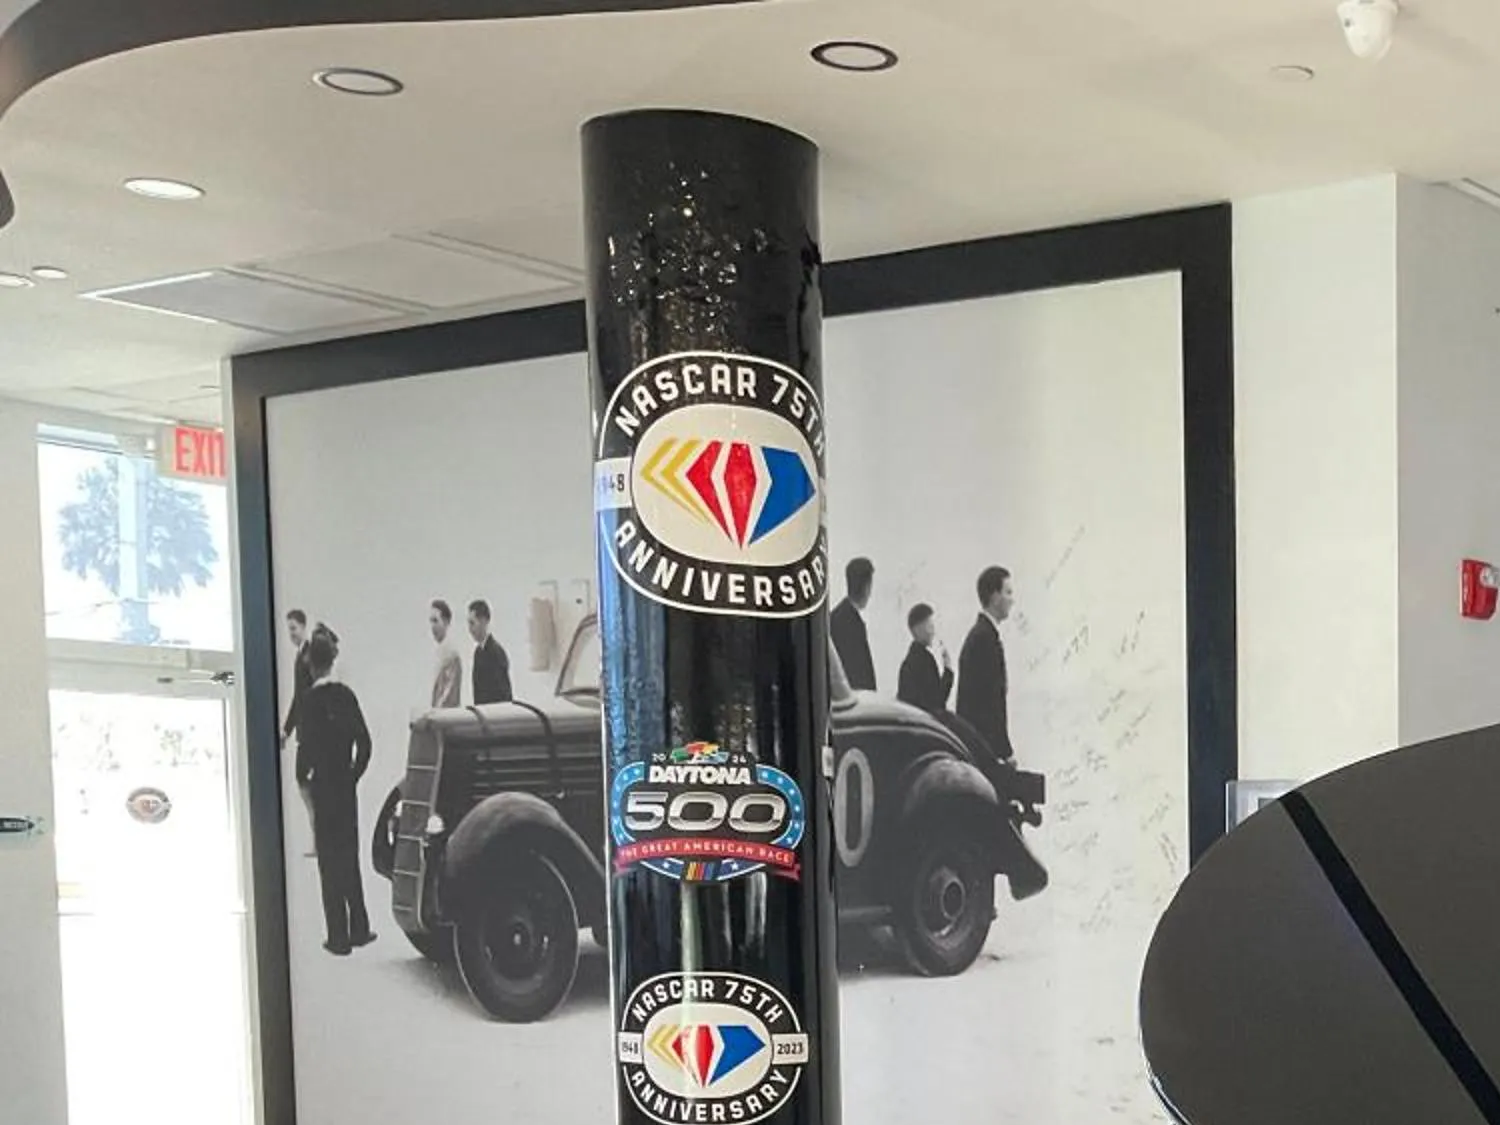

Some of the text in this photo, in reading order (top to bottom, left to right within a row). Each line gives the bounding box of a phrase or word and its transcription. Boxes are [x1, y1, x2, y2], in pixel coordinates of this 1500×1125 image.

[615, 363, 825, 456] NASCAR 75TH
[648, 765, 751, 785] DAYTONA
[624, 791, 787, 833] 500
[683, 841, 753, 855] AMERICAN
[759, 847, 790, 863] RACE
[631, 979, 784, 1023] NASCAR 75TH
[631, 1069, 789, 1121] ANNIVERSARY
